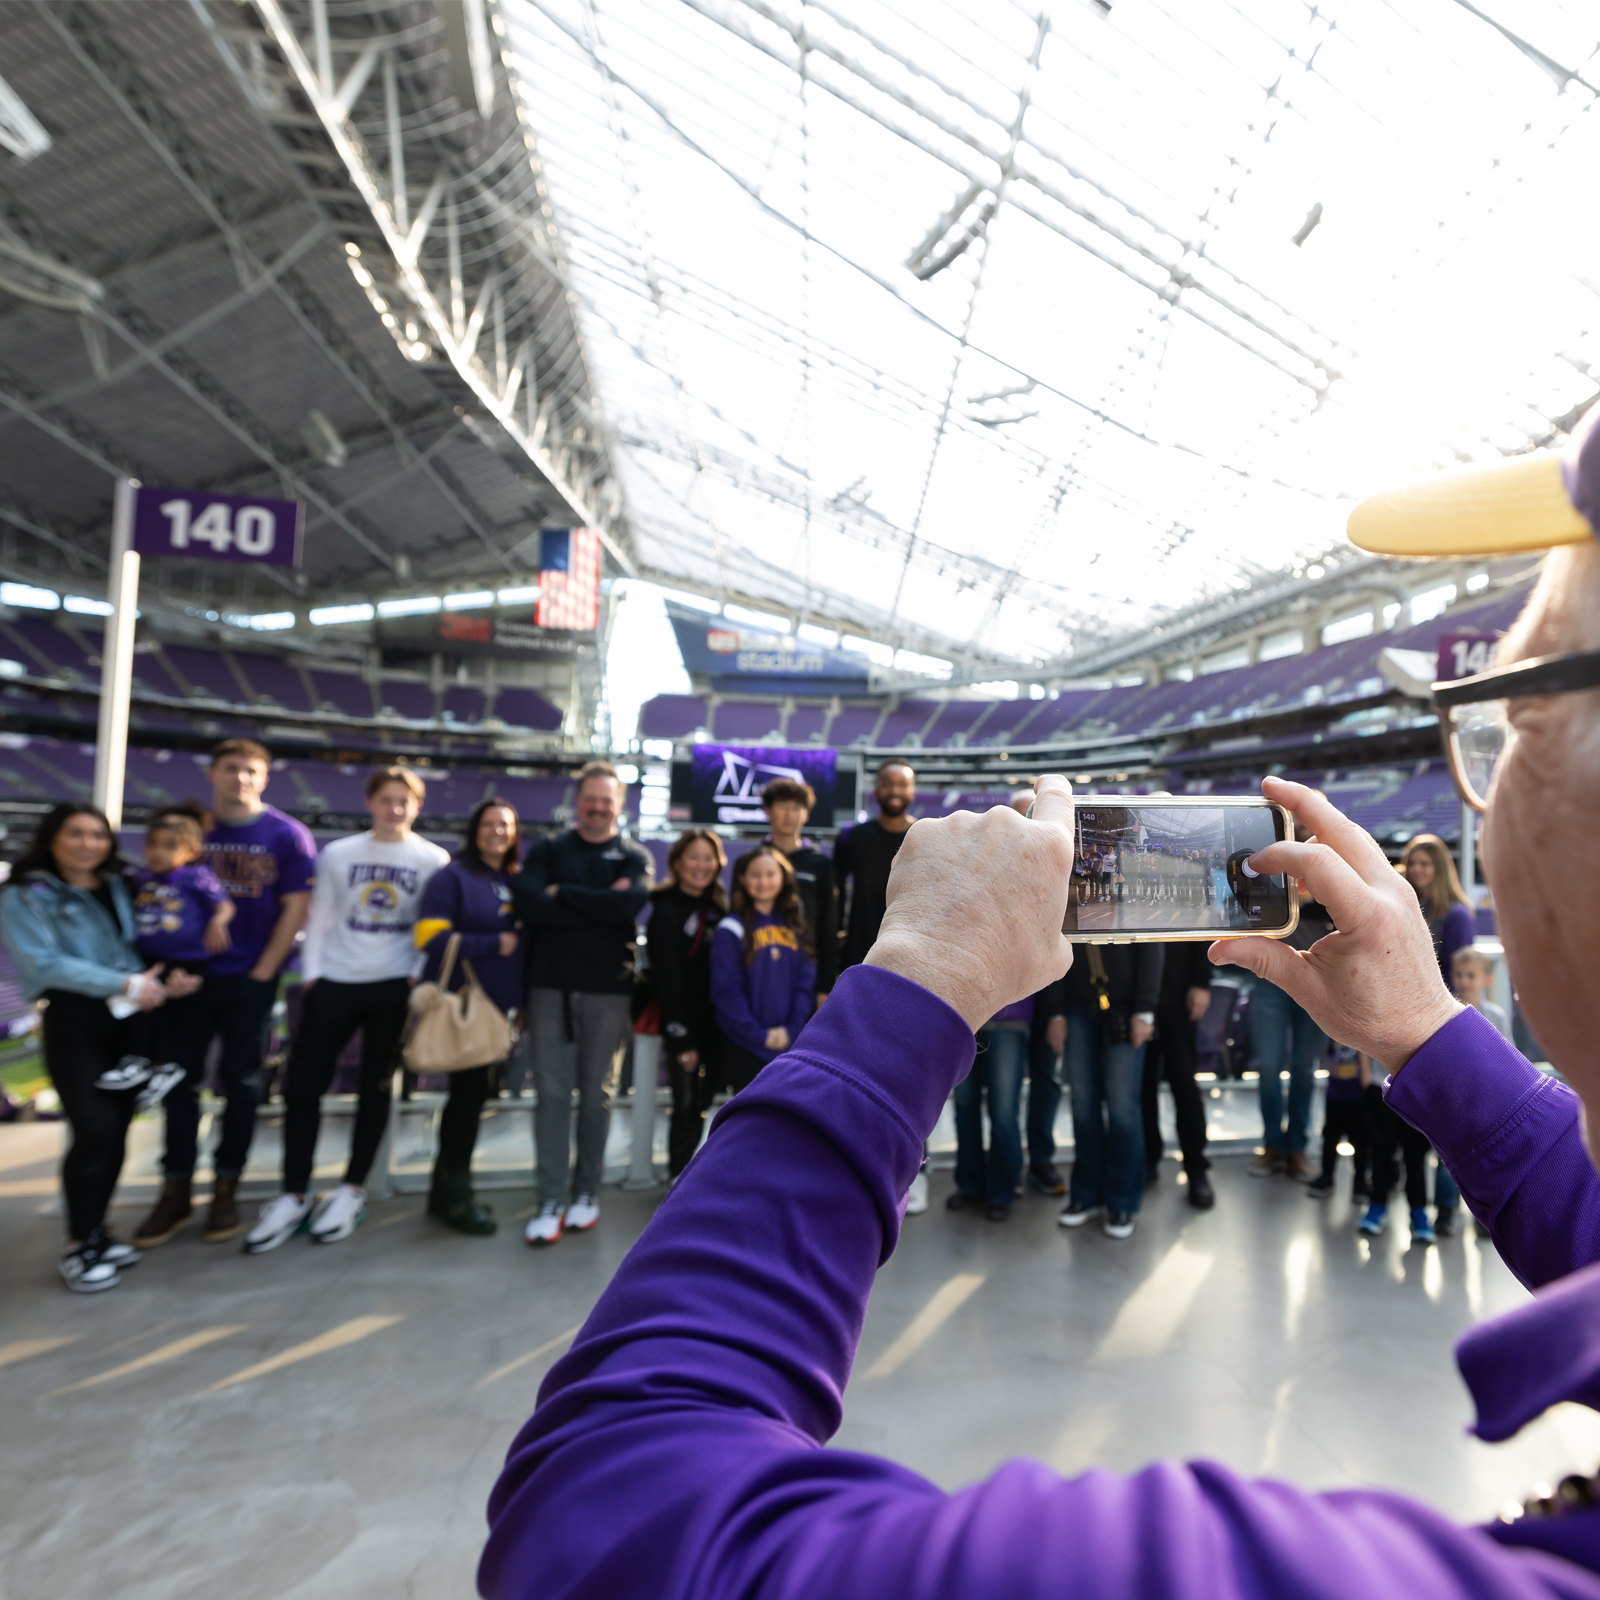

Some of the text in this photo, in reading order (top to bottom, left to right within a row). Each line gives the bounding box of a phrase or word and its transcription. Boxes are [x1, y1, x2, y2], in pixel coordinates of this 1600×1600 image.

[159, 498, 277, 556] 140
[736, 650, 824, 672] stadium
[1082, 813, 1096, 821] 140
